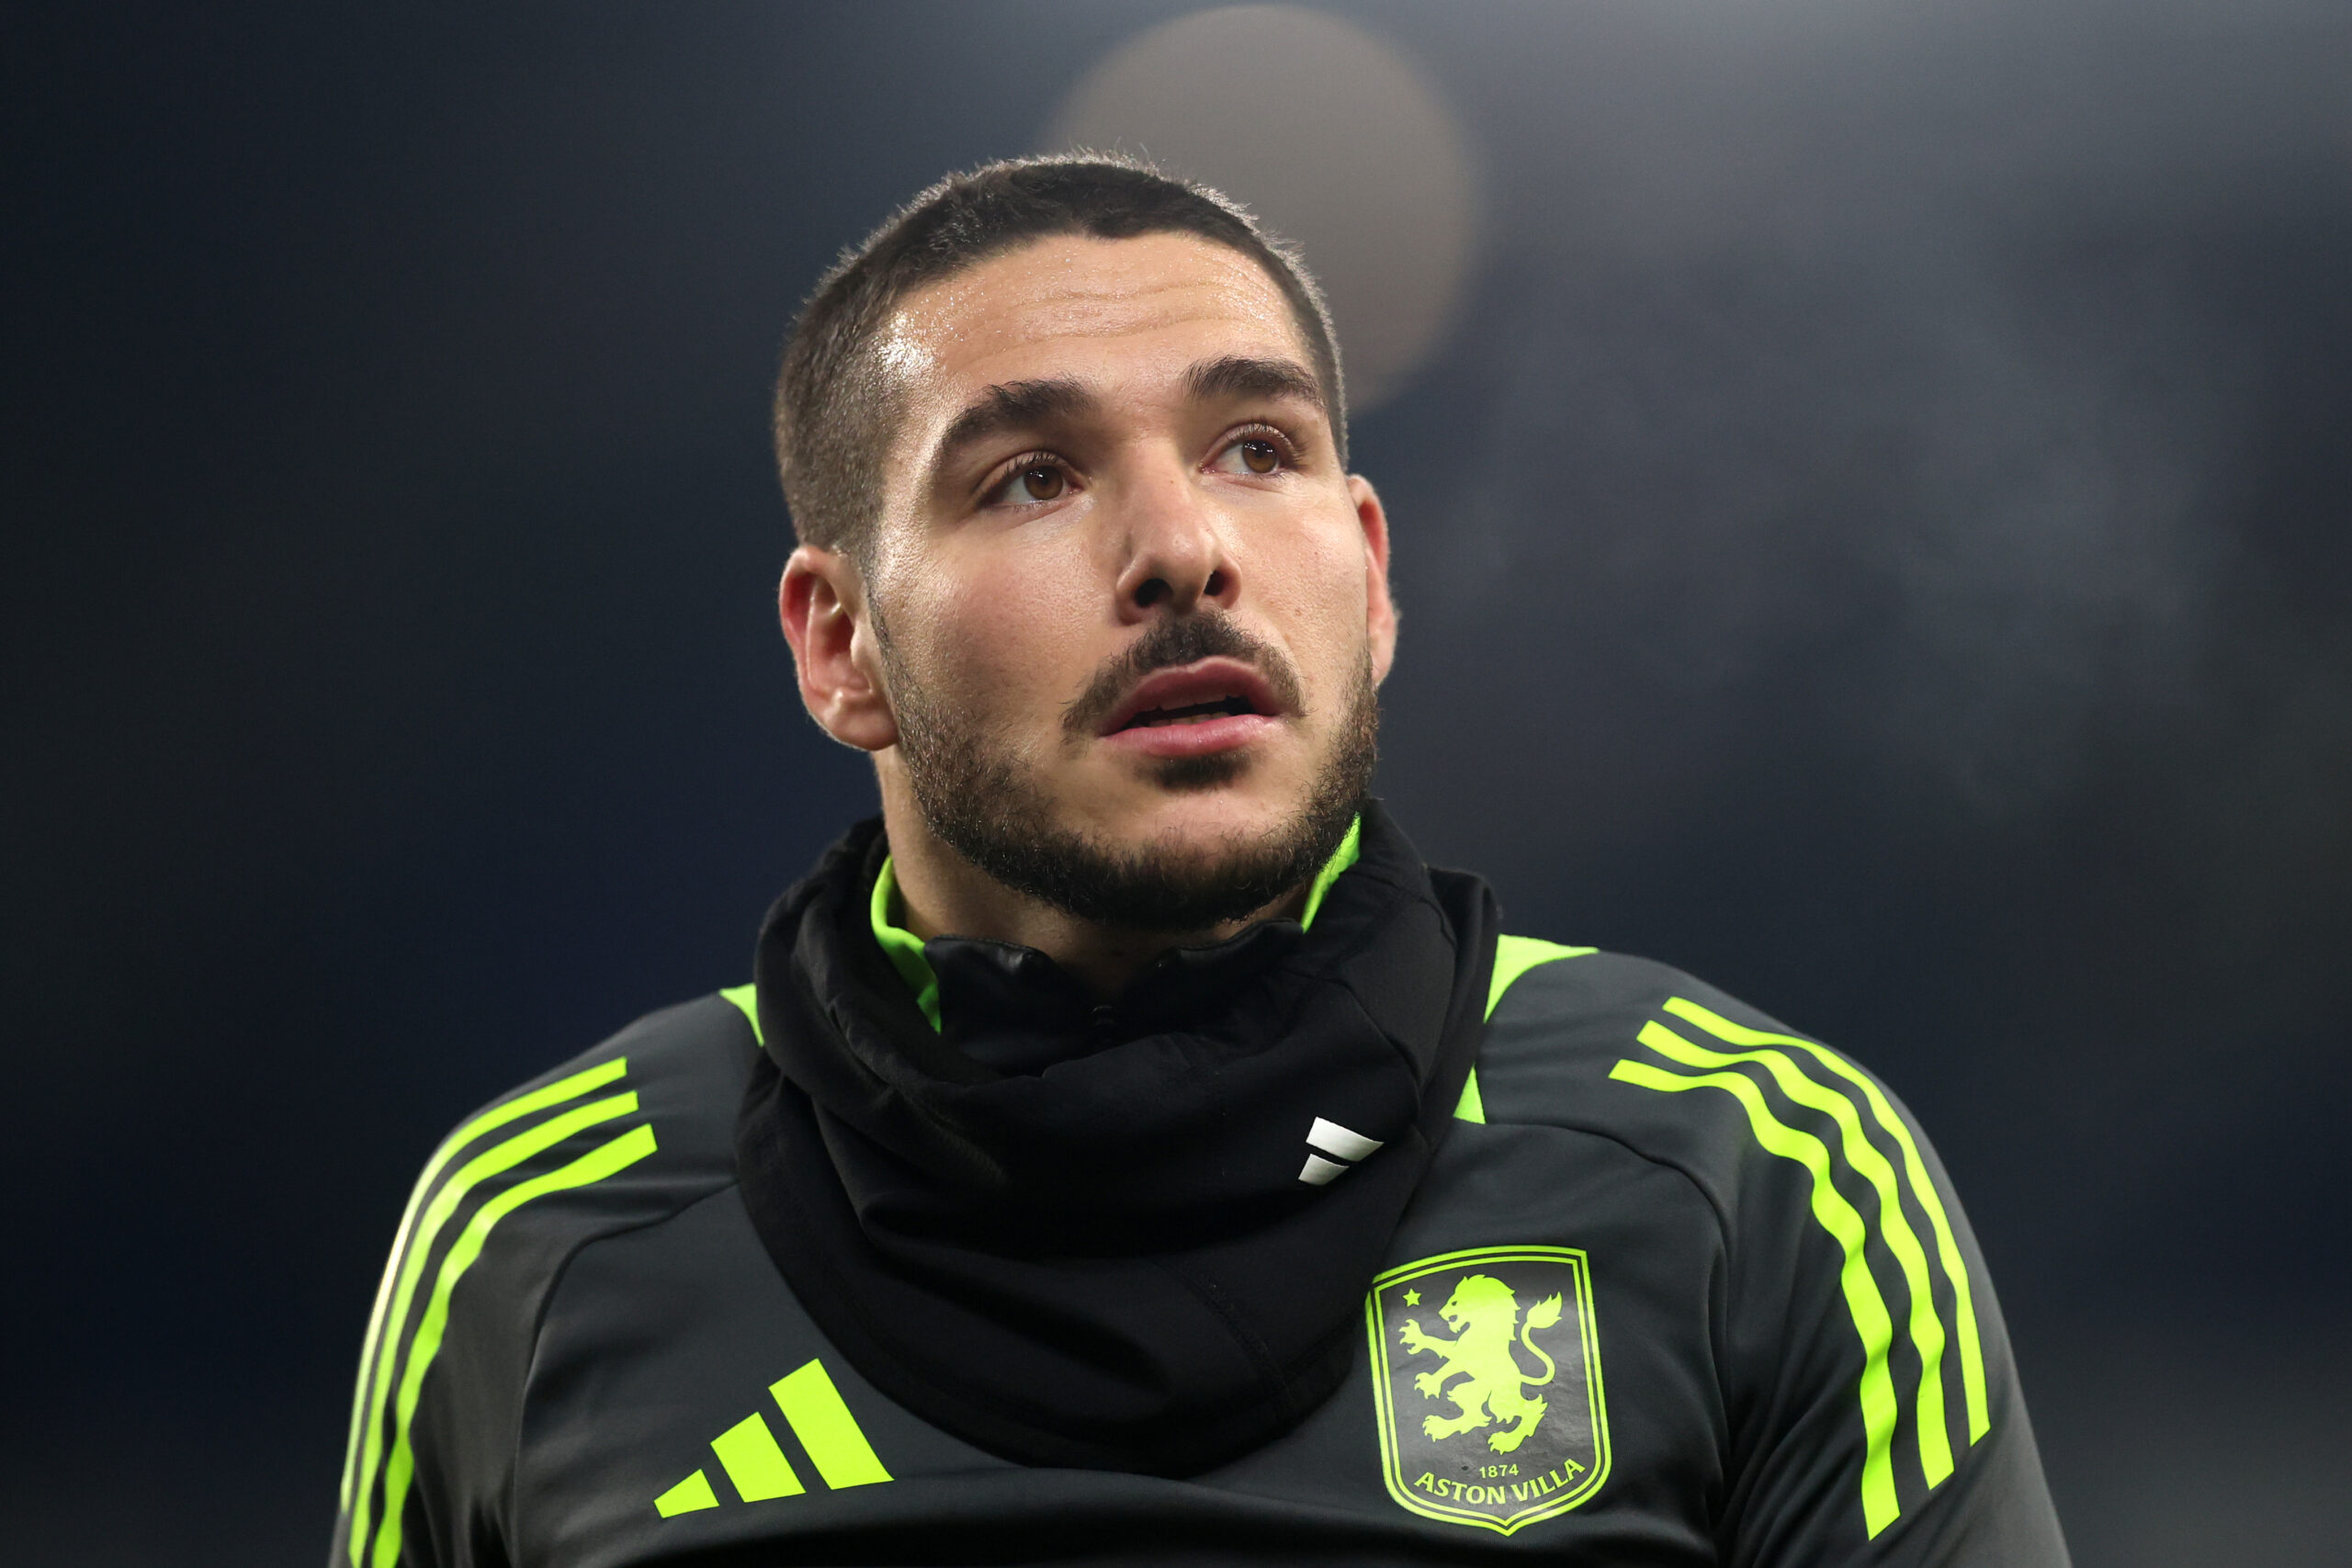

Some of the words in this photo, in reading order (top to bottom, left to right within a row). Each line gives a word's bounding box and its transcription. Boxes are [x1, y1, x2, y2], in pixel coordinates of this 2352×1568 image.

[1413, 1472, 1507, 1505] ASTON
[1510, 1458, 1586, 1502] VILLA
[1479, 1464, 1519, 1479] 1874
